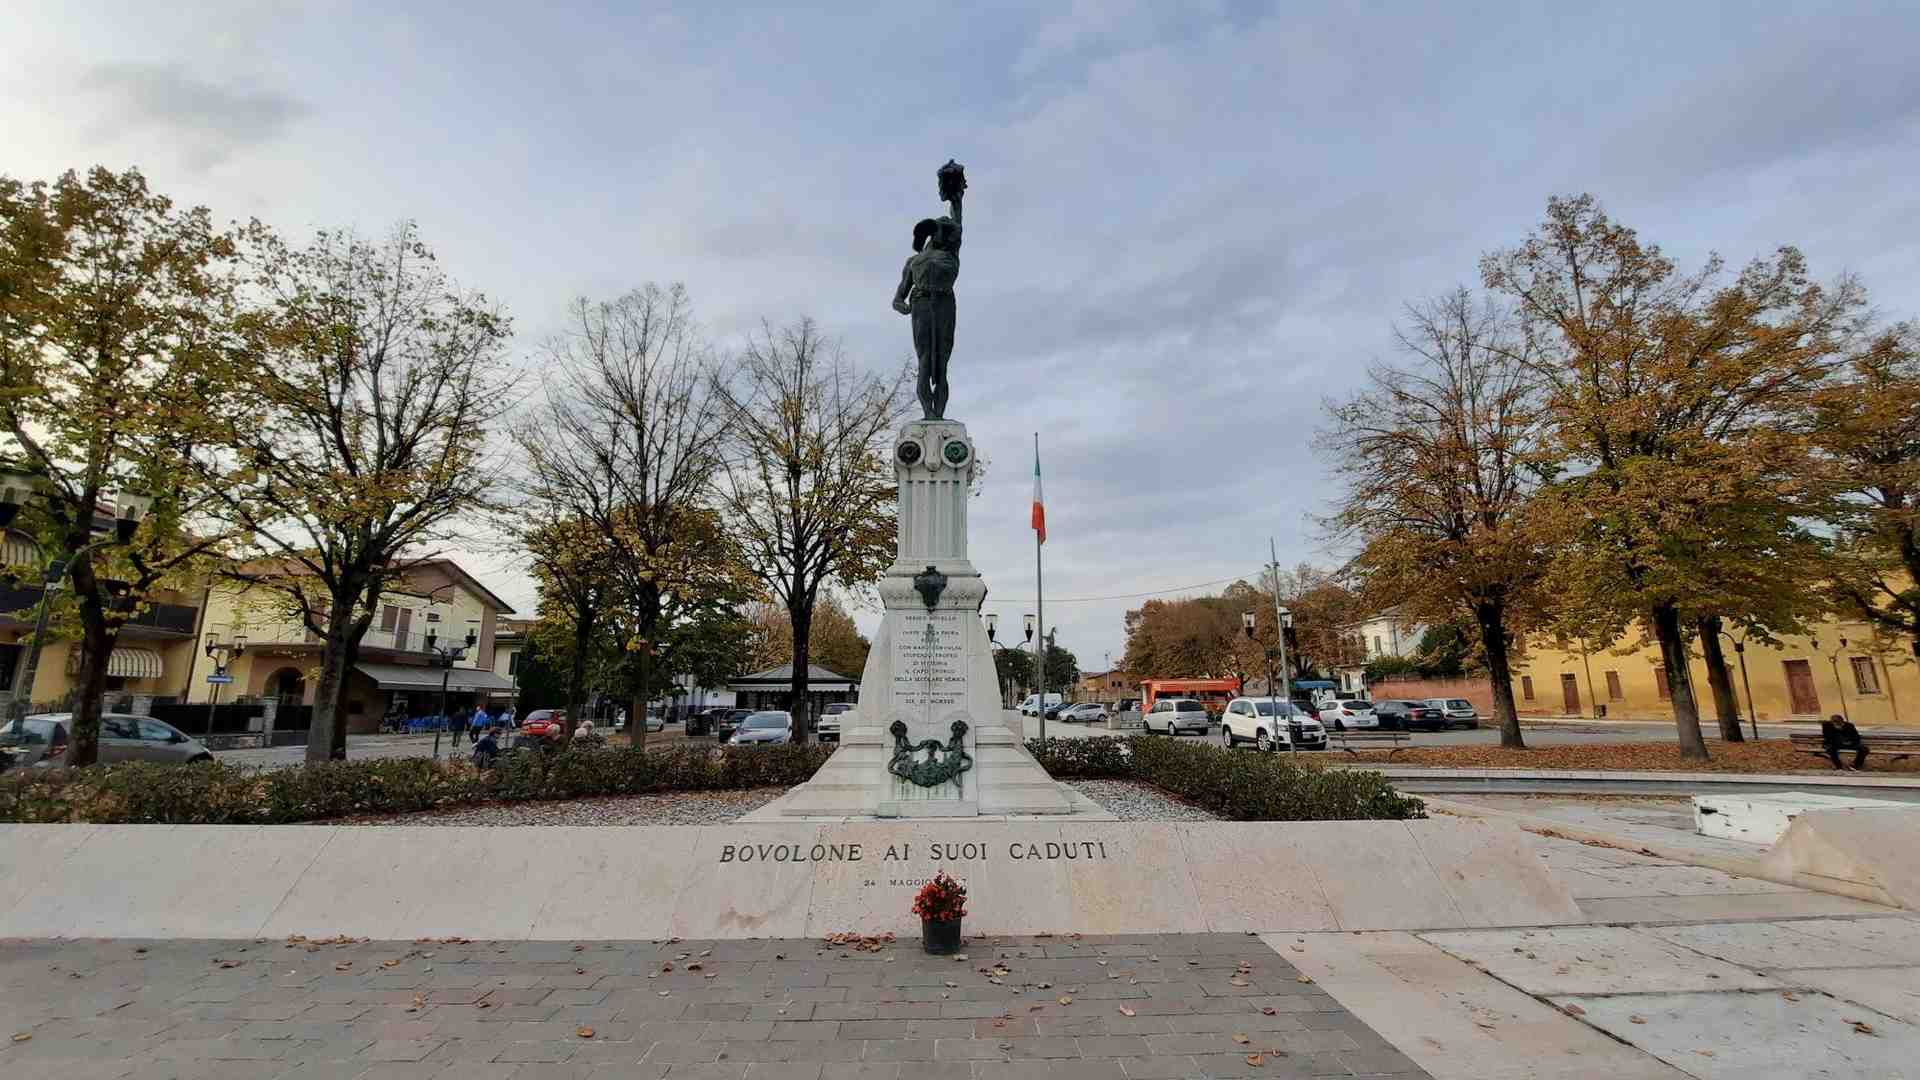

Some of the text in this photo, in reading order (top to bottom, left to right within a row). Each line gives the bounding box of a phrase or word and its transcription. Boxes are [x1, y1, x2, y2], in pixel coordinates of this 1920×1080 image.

[720, 842, 1107, 863] BOVOLONE AI SUOI CADUTI
